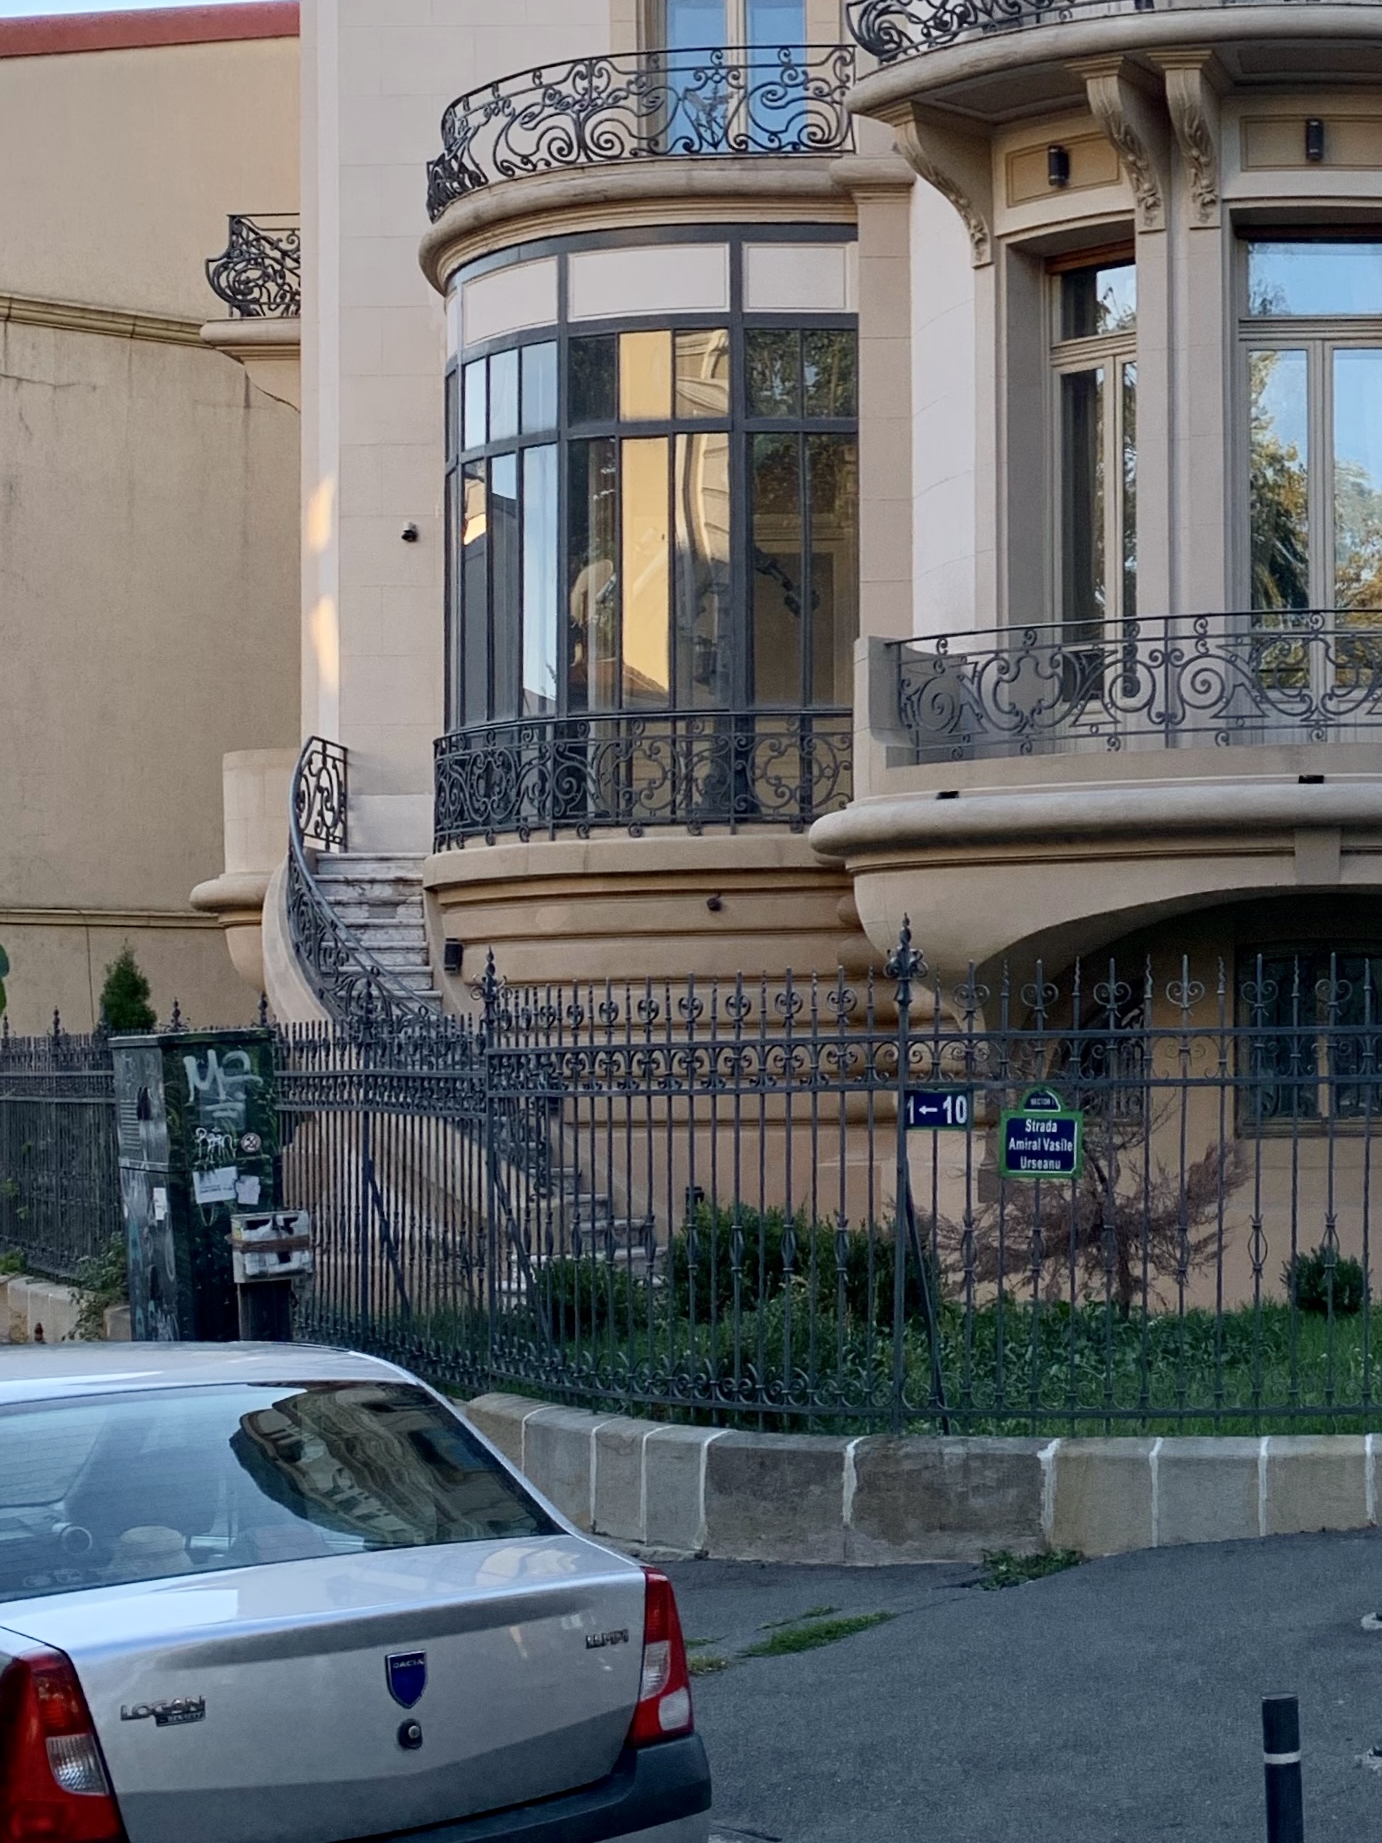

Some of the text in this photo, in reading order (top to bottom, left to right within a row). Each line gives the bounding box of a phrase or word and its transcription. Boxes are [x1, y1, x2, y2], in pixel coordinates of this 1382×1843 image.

[907, 1095, 967, 1124] 1 10
[1025, 1119, 1058, 1133] Strada
[1008, 1137, 1073, 1152] Amiral Vasile
[1020, 1156, 1062, 1170] Urseanu
[392, 1659, 424, 1668] DACIA
[121, 1695, 205, 1721] LOGAN
